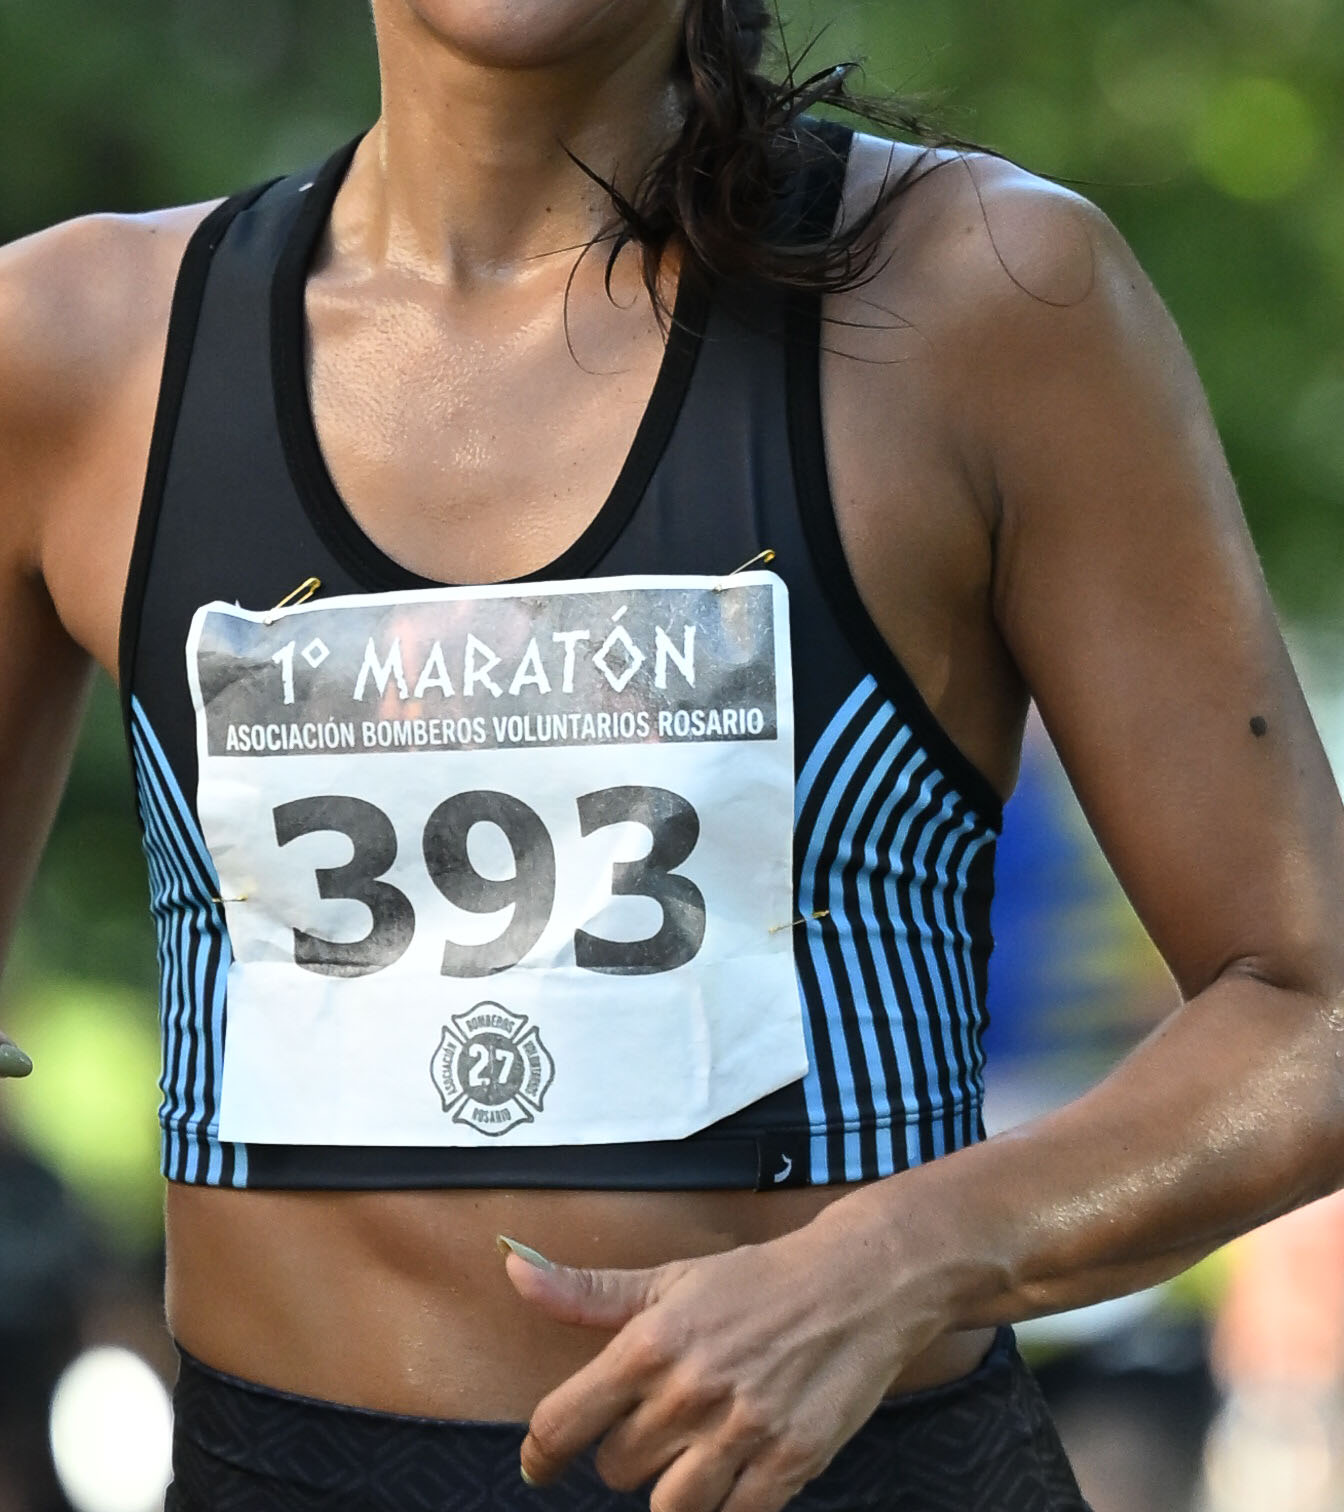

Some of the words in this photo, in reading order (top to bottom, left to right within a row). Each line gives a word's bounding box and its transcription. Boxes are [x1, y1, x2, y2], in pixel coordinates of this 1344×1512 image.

[352, 605, 697, 702] MARATÓN
[225, 716, 356, 752] ASOCIACIÓN
[361, 717, 486, 748] BOMBEROS
[492, 711, 650, 743] VOLUNTARIOS
[658, 707, 765, 738] ROSARIO
[272, 784, 707, 979] 393
[468, 1043, 514, 1087] 27
